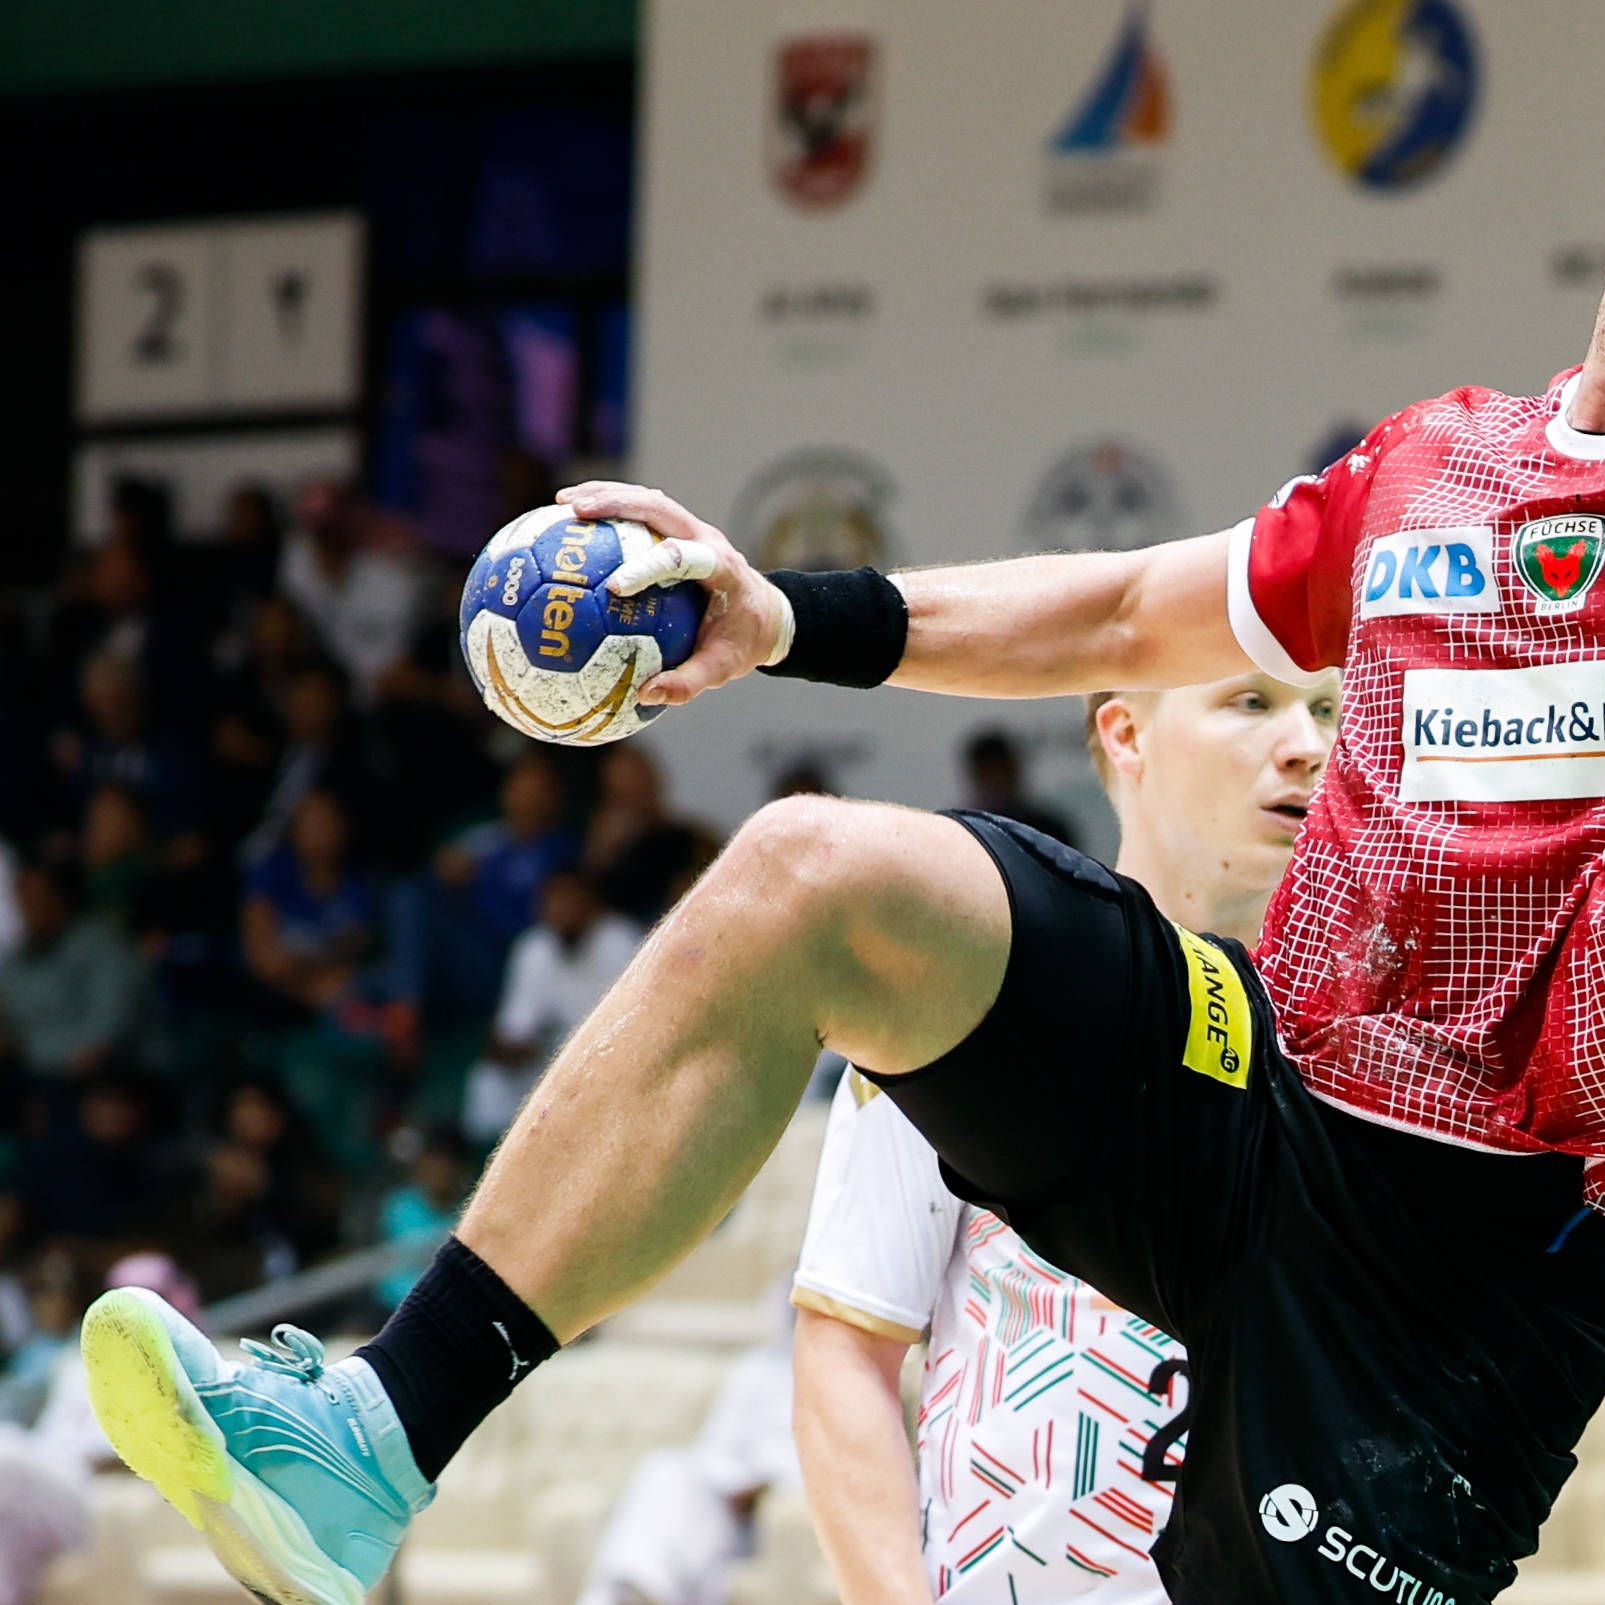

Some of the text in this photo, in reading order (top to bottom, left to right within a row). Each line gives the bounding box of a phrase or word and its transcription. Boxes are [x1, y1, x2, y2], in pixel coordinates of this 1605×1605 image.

[1529, 520, 1598, 541] FÜCHSE
[538, 519, 596, 657] molten
[1366, 542, 1487, 602] DKB
[1541, 599, 1579, 612] BERLIN
